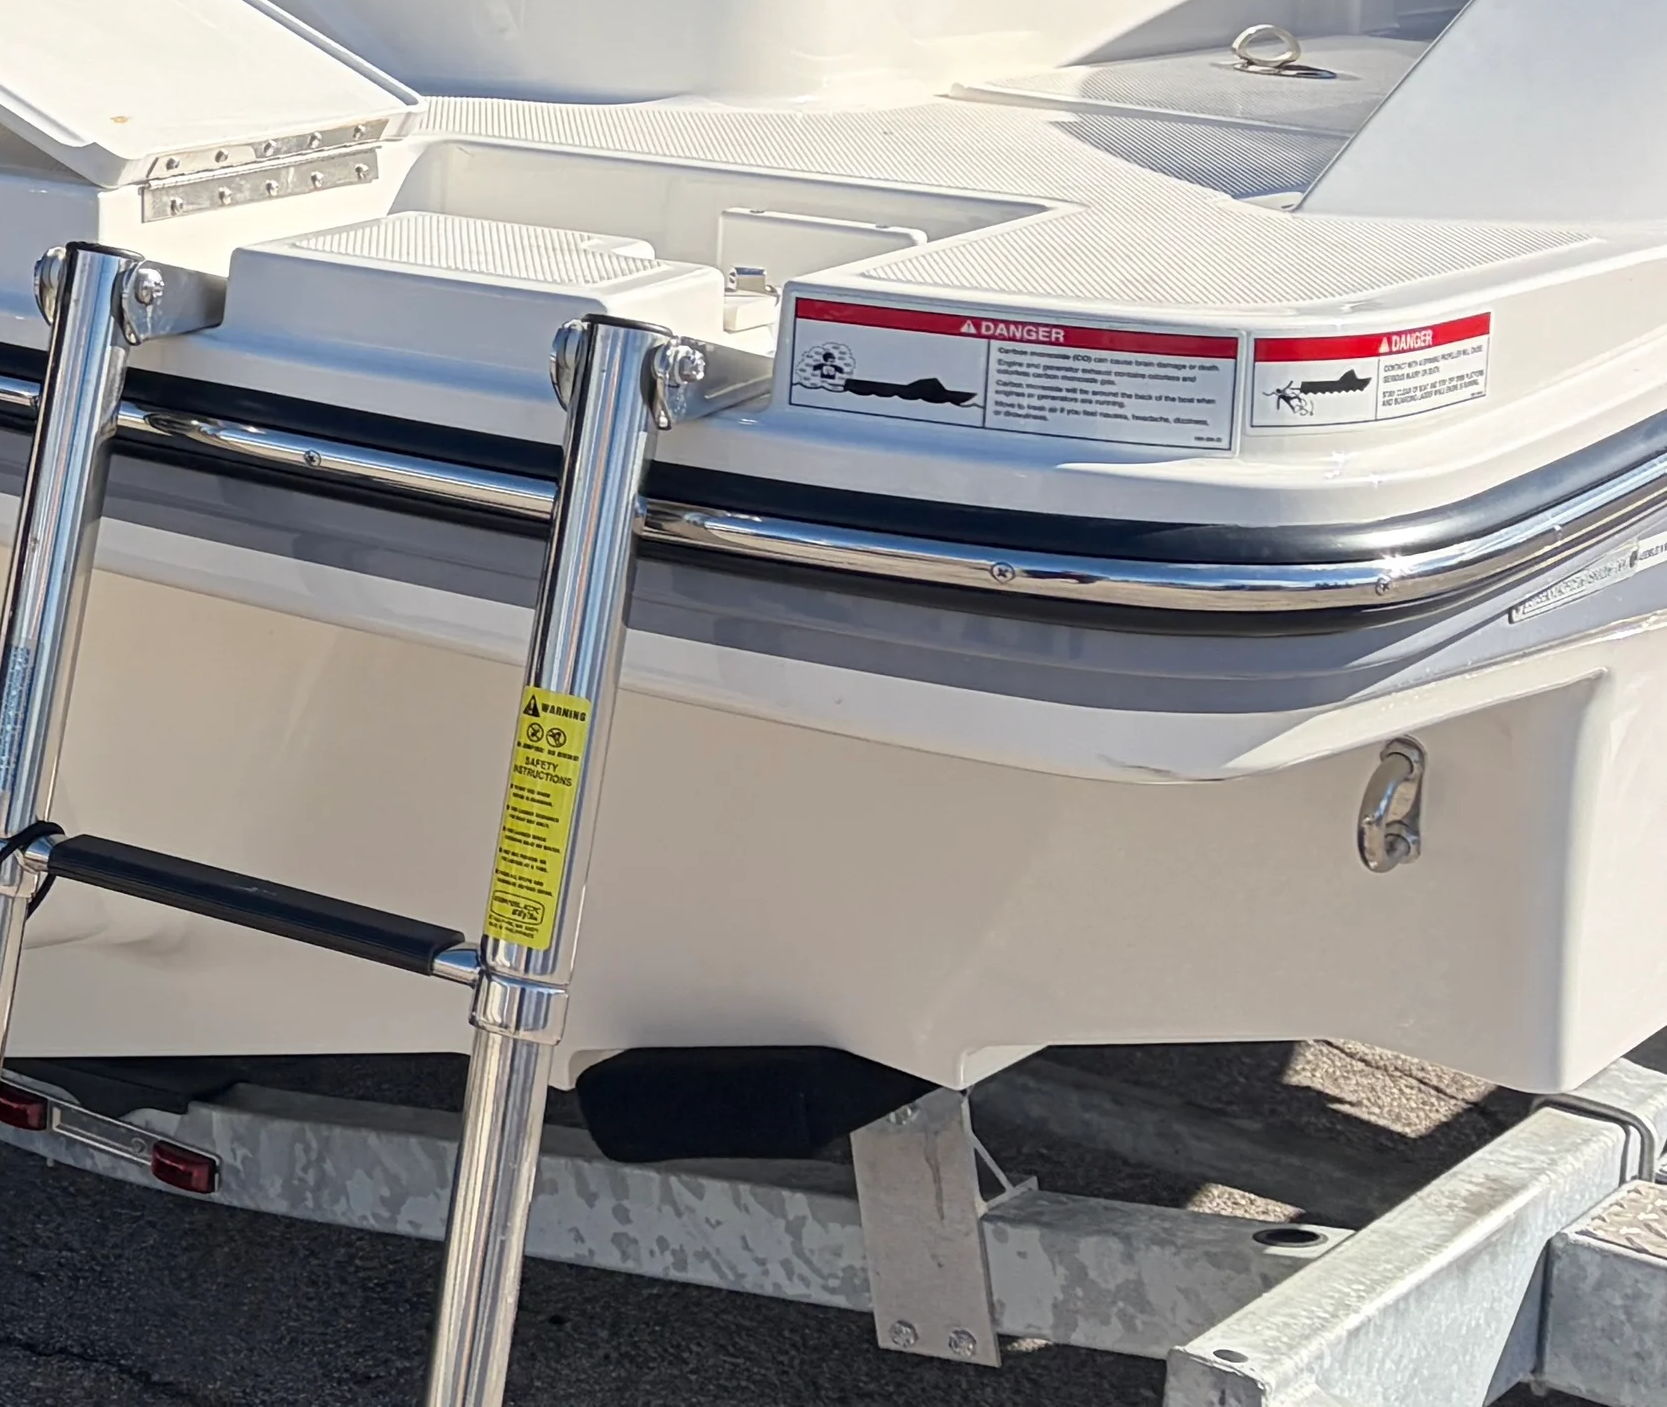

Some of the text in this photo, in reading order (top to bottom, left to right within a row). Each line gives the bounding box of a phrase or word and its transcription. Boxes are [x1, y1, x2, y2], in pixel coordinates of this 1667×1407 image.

[981, 321, 1064, 342] DANGER
[1391, 329, 1434, 352] DANGER
[541, 702, 587, 722] WARNING
[524, 756, 559, 773] SAFETY
